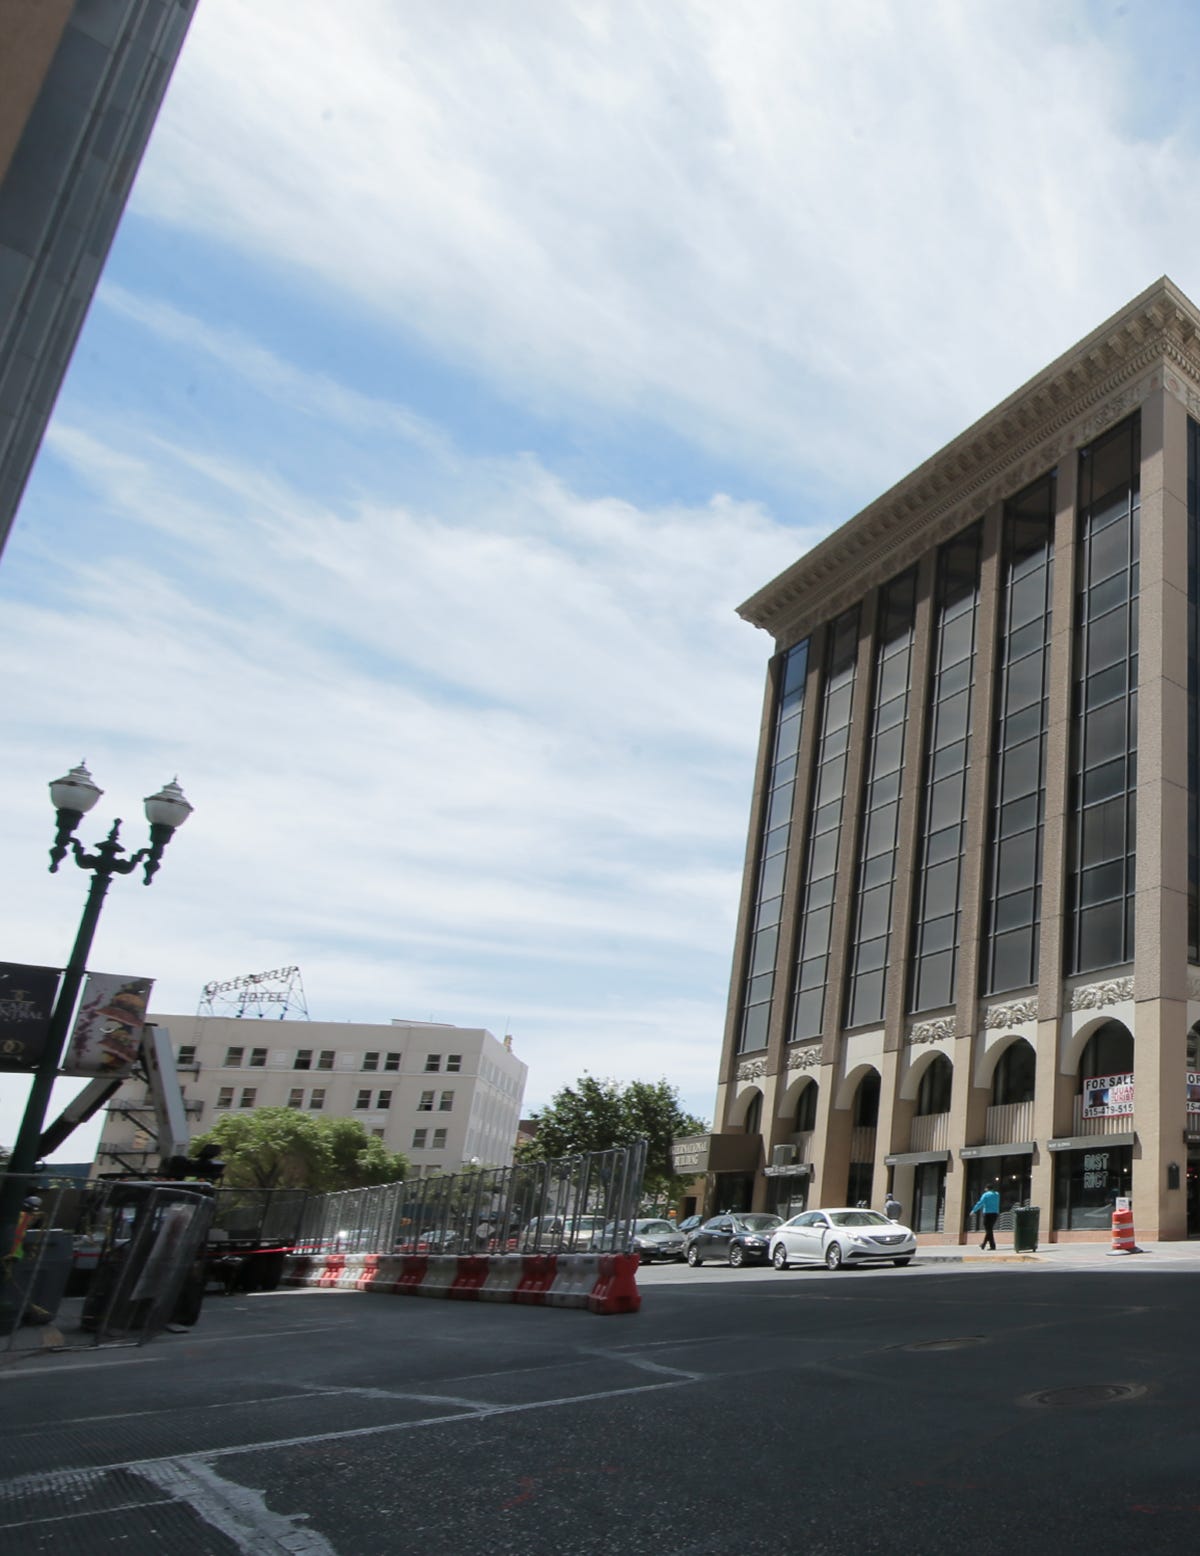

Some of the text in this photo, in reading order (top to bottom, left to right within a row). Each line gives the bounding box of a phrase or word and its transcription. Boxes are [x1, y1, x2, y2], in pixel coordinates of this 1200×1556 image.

[203, 966, 299, 1001] Gateway
[239, 991, 288, 1003] HOTEL
[1086, 1074, 1135, 1090] FOR SALE
[1084, 1103, 1134, 1117] 915-479-515
